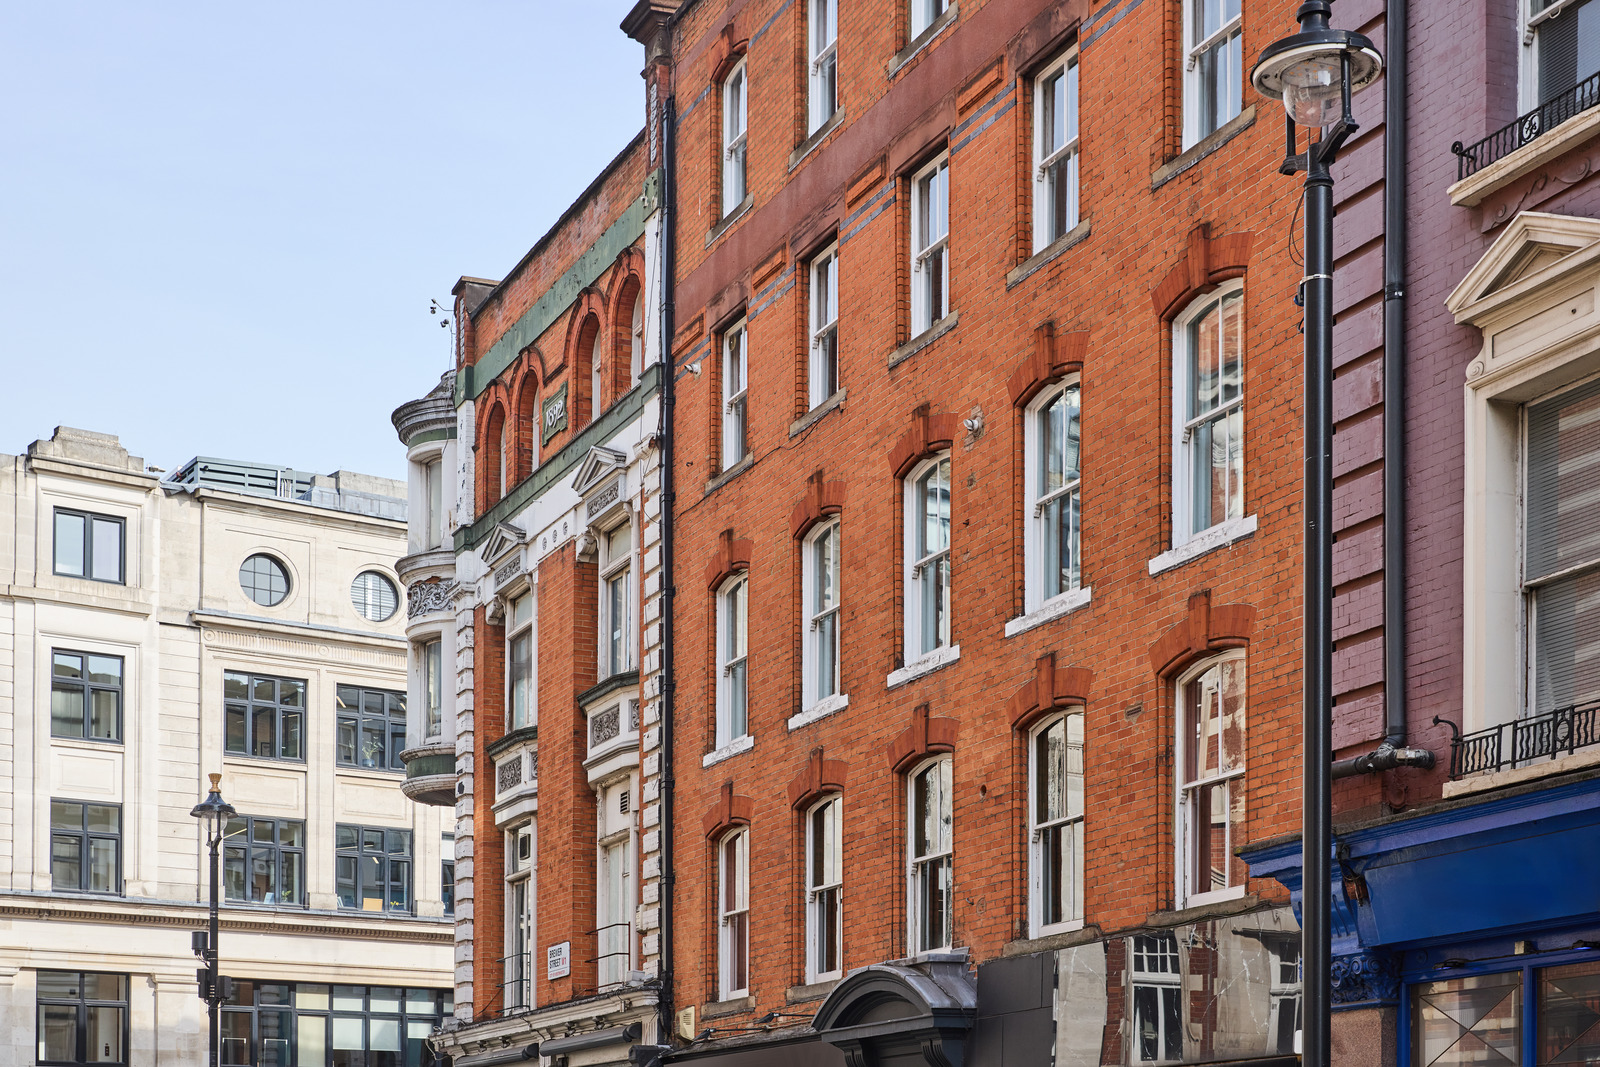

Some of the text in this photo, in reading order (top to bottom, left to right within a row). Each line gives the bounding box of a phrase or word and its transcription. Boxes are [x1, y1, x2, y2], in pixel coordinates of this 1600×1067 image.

[545, 400, 564, 433] 1892
[550, 947, 562, 959] BREWER
[550, 958, 561, 969] STREET
